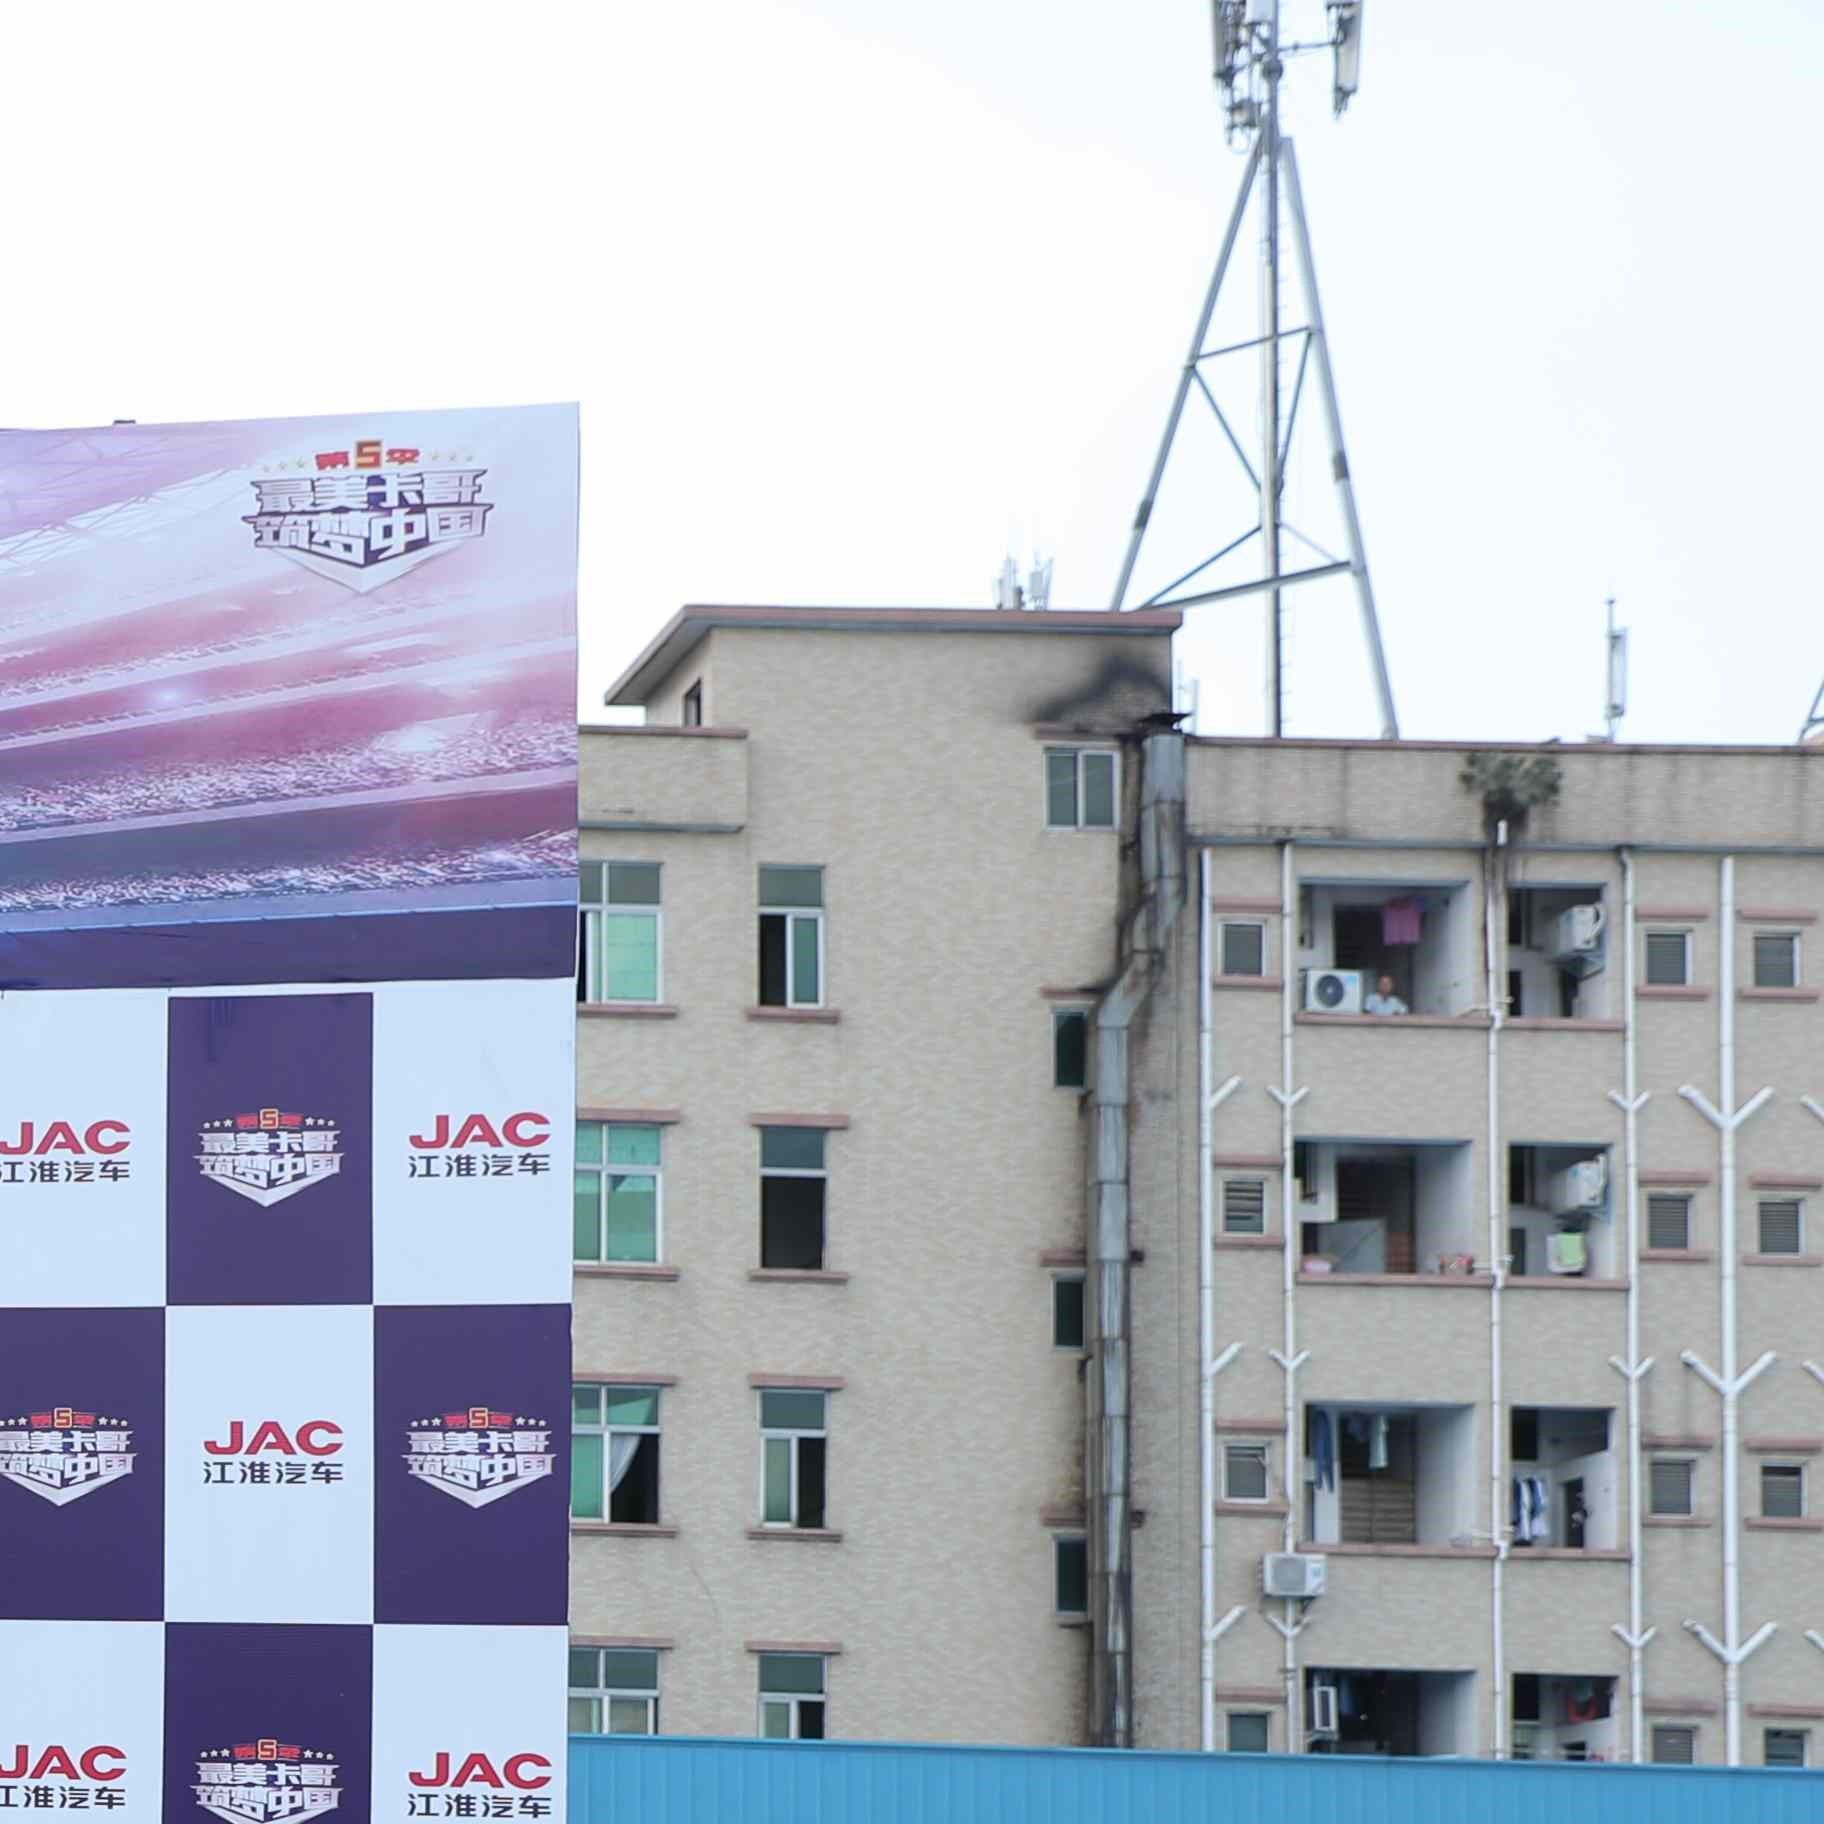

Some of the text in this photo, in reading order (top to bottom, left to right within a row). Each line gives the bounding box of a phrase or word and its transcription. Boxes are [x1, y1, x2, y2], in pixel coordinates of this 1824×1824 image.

[250, 469, 488, 513] 最美卡哥
[410, 1112, 550, 1150] JAC
[408, 1154, 551, 1178] 江淮汽车
[205, 1420, 342, 1456] JAC
[405, 1430, 552, 1453] 最美卡哥
[204, 1461, 343, 1485] 江淮汽车
[195, 1762, 340, 1785] 最美卡哥
[409, 1753, 550, 1790] JAC
[190, 1786, 344, 1822] 筑梦中国
[408, 1793, 551, 1819] 江淮汽车
